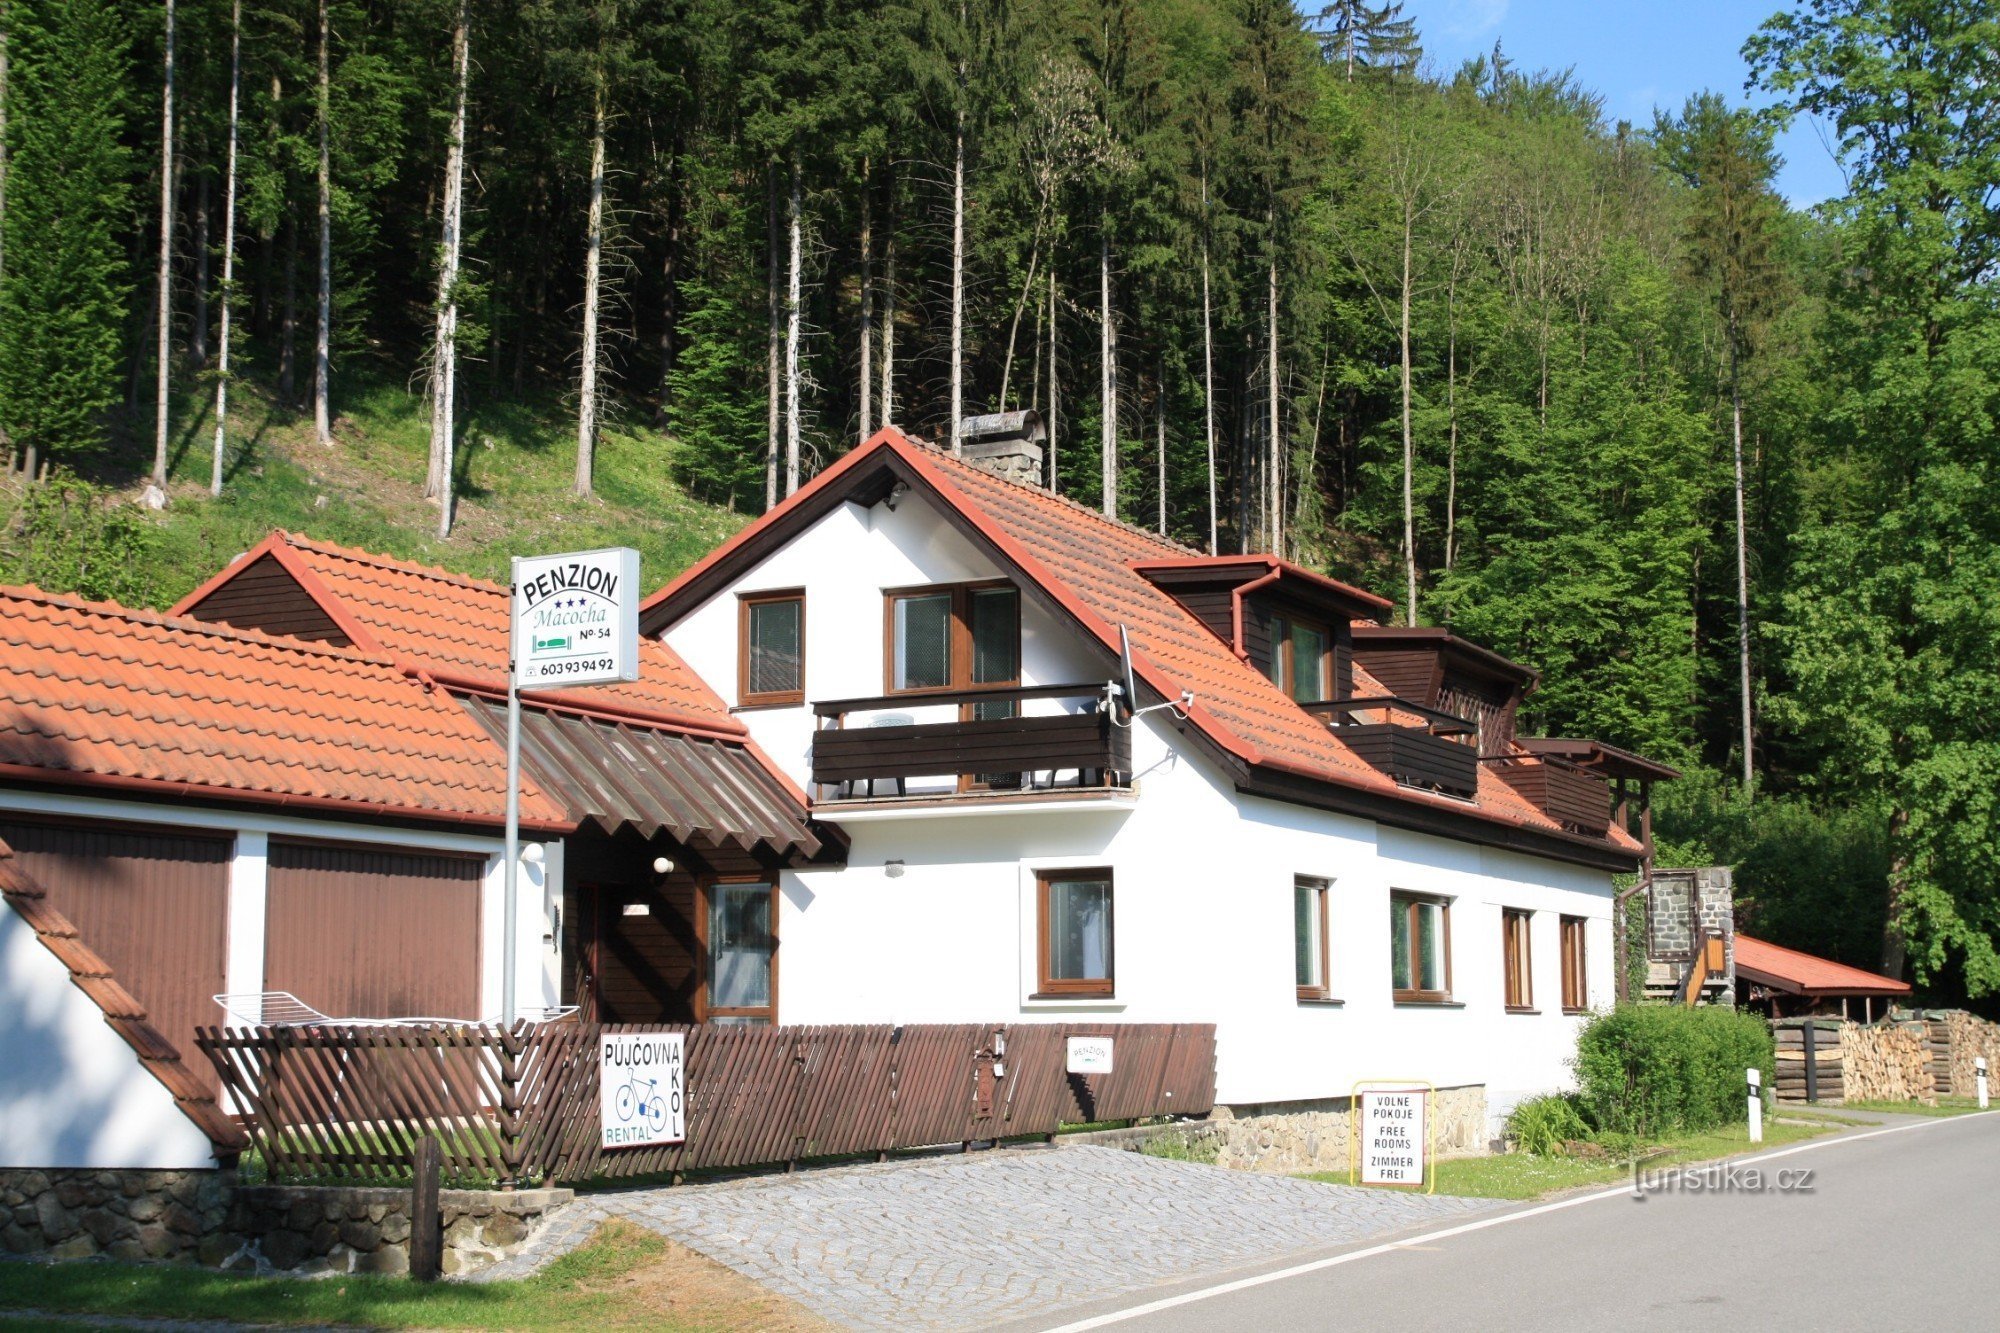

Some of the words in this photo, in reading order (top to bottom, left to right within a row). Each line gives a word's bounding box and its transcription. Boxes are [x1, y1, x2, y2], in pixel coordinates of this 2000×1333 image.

[523, 564, 618, 606] PENZION
[533, 601, 606, 629] Macocha
[598, 628, 610, 638] 54
[541, 663, 563, 675] 603
[605, 1036, 680, 1066] PŮJČOVNA
[1073, 1046, 1105, 1058] PENZION
[1374, 1108, 1412, 1119] POKOJE
[606, 1126, 652, 1143] RENTAL
[1380, 1126, 1406, 1136] FREE
[1374, 1138, 1411, 1149] ROOMS
[1372, 1156, 1413, 1167] ZIMMER
[1380, 1169, 1404, 1179] FREI
